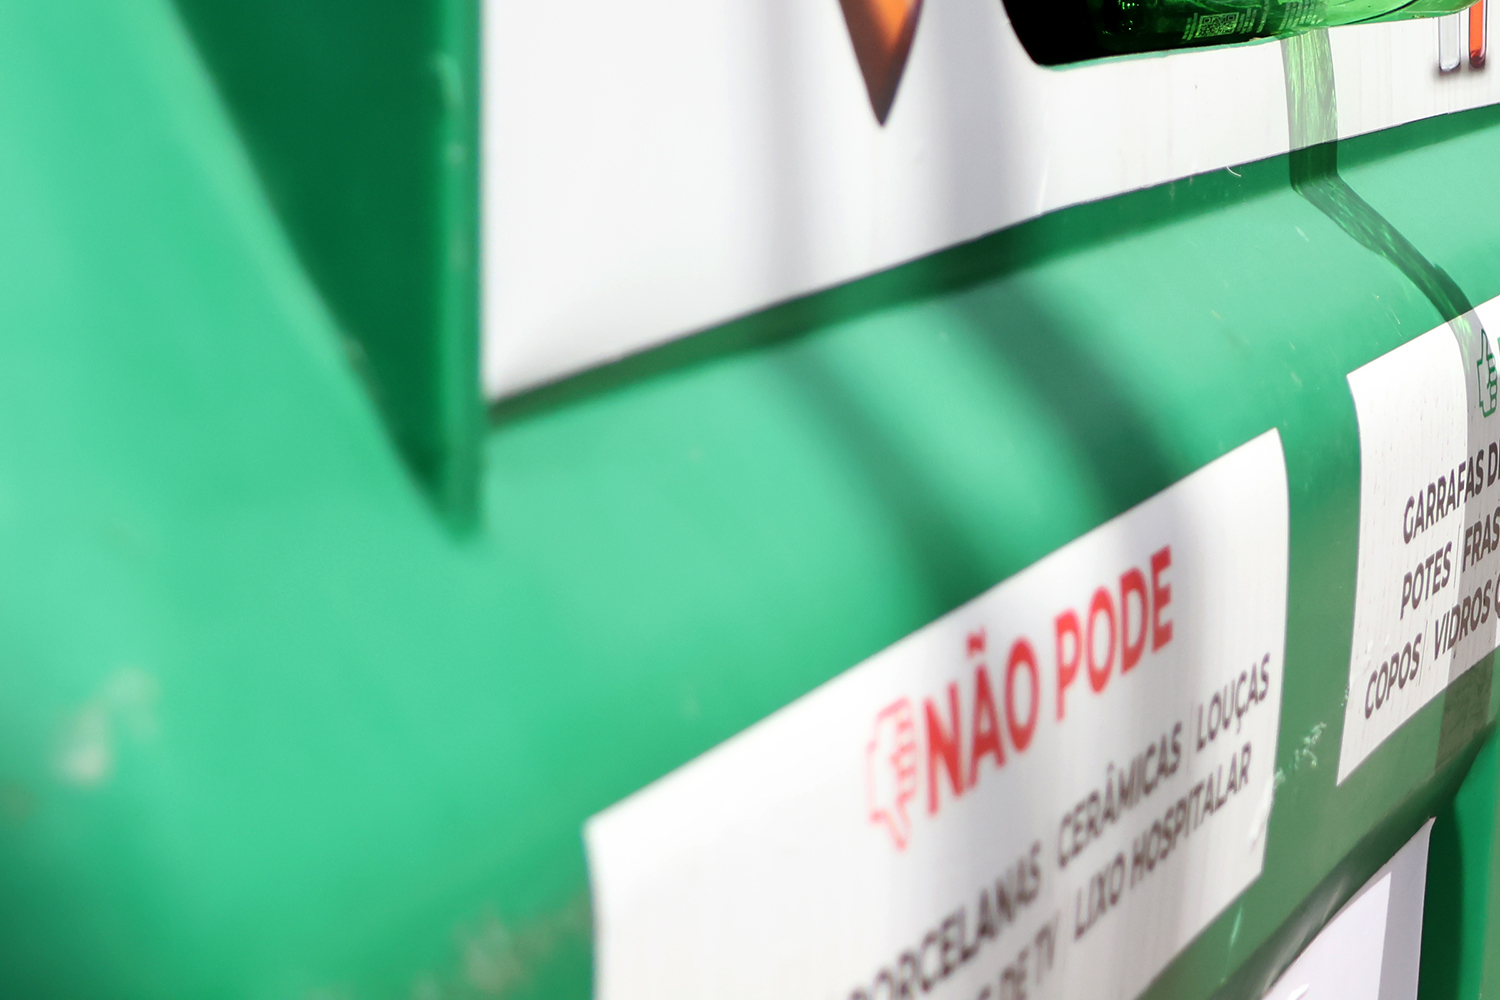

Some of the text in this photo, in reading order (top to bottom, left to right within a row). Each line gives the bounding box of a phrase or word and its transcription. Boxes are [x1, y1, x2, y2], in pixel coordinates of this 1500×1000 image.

[1400, 541, 1452, 620] POTES
[1403, 449, 1484, 544] GARRAFAS
[923, 544, 1173, 816] NÃO PODE
[1365, 632, 1422, 719] COPOS
[1434, 579, 1492, 661] VIDROS
[1058, 720, 1182, 869] CERÂMICAS
[1196, 652, 1270, 752] LOUÇAS
[1075, 852, 1126, 939] LIXO
[1130, 741, 1251, 888] HOSPITALAR
